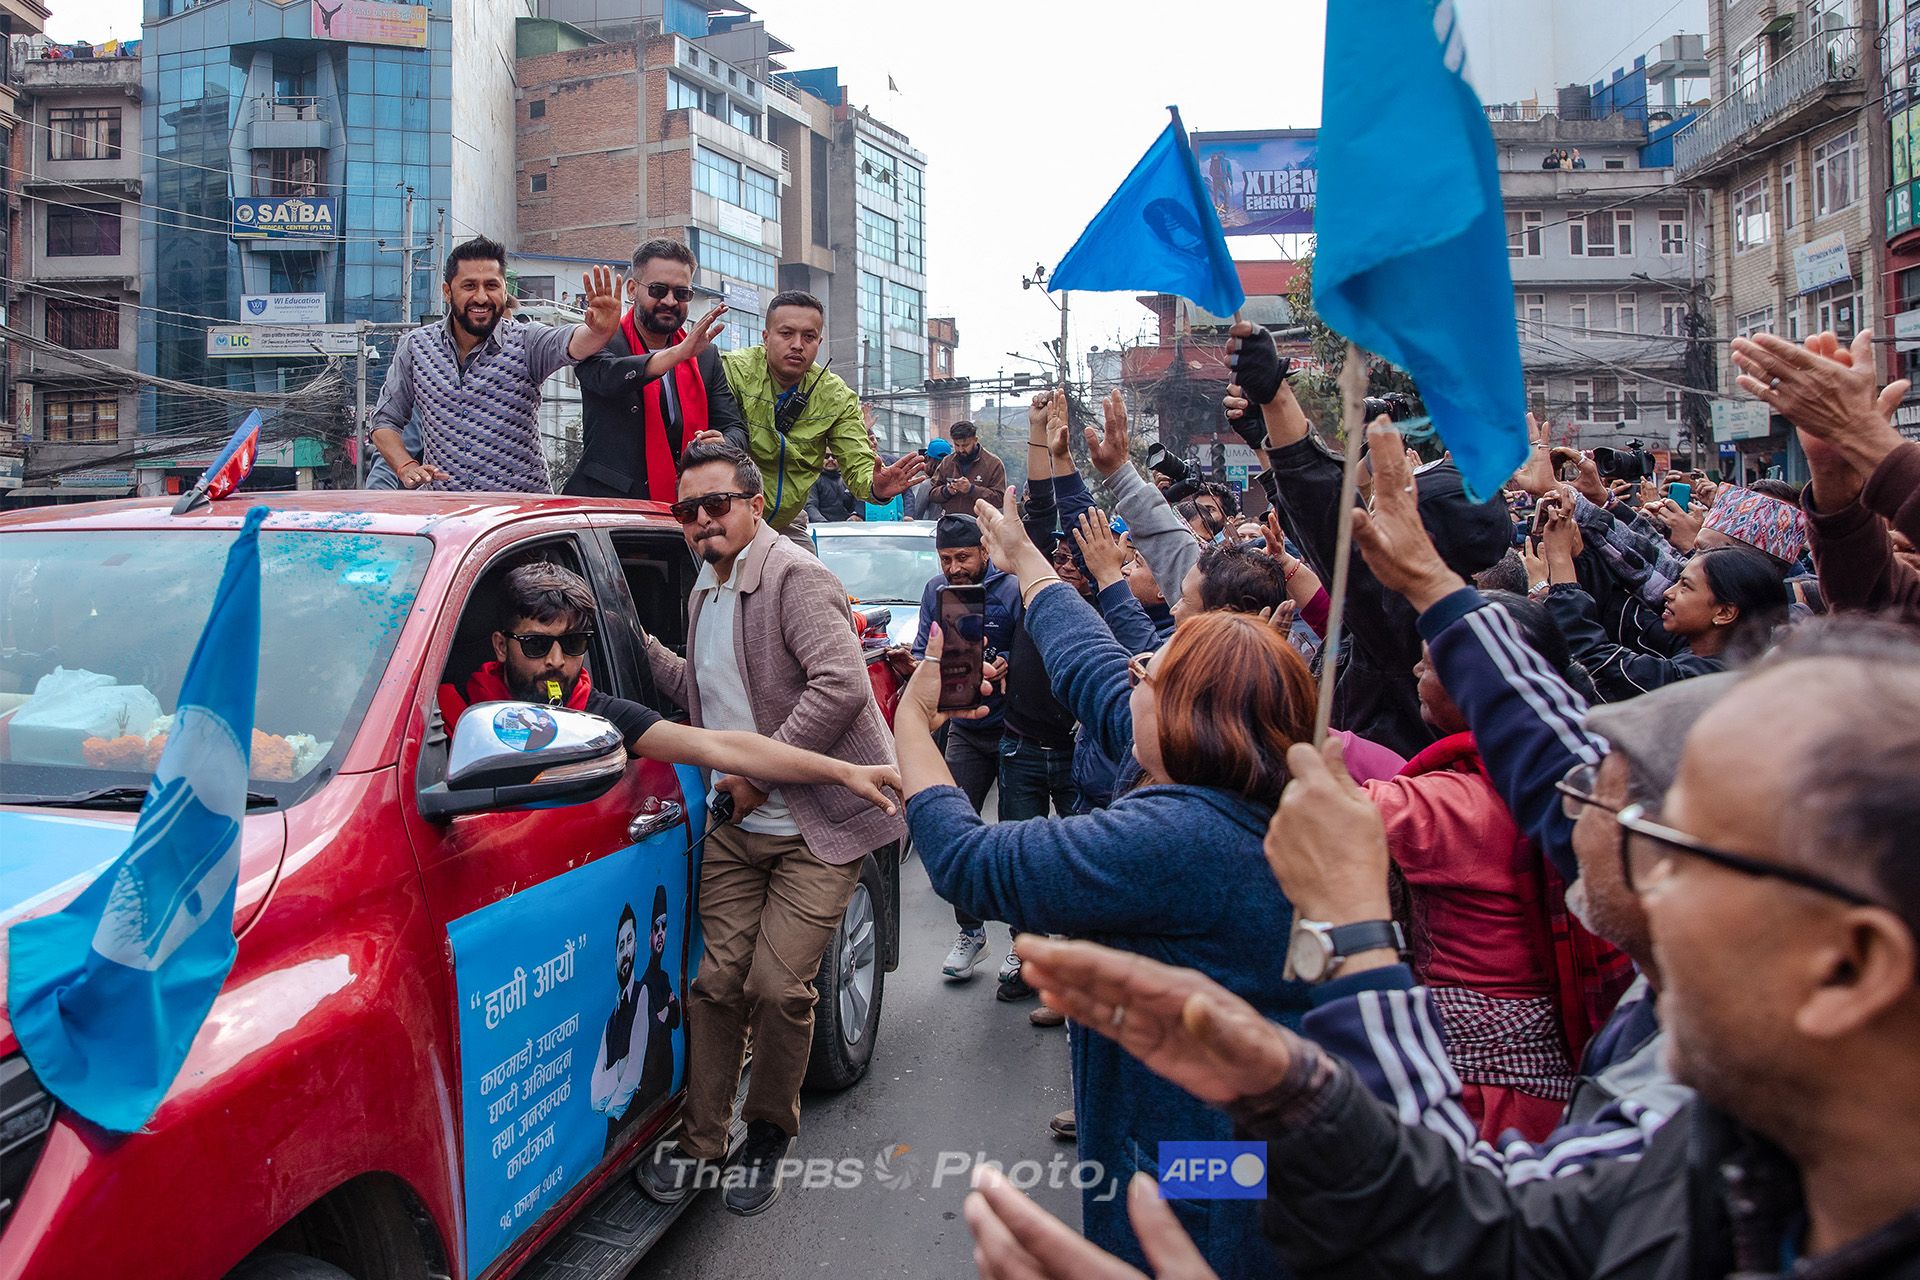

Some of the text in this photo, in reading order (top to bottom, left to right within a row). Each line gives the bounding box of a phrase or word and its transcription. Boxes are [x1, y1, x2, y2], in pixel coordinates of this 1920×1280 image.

[1246, 194, 1296, 210] ENERGY
[230, 335, 250, 347] LIC
[536, 1012, 580, 1058] उपत्यका
[521, 1047, 573, 1101] अभिवादन
[492, 1073, 571, 1159] तथा जनसम्पर्क
